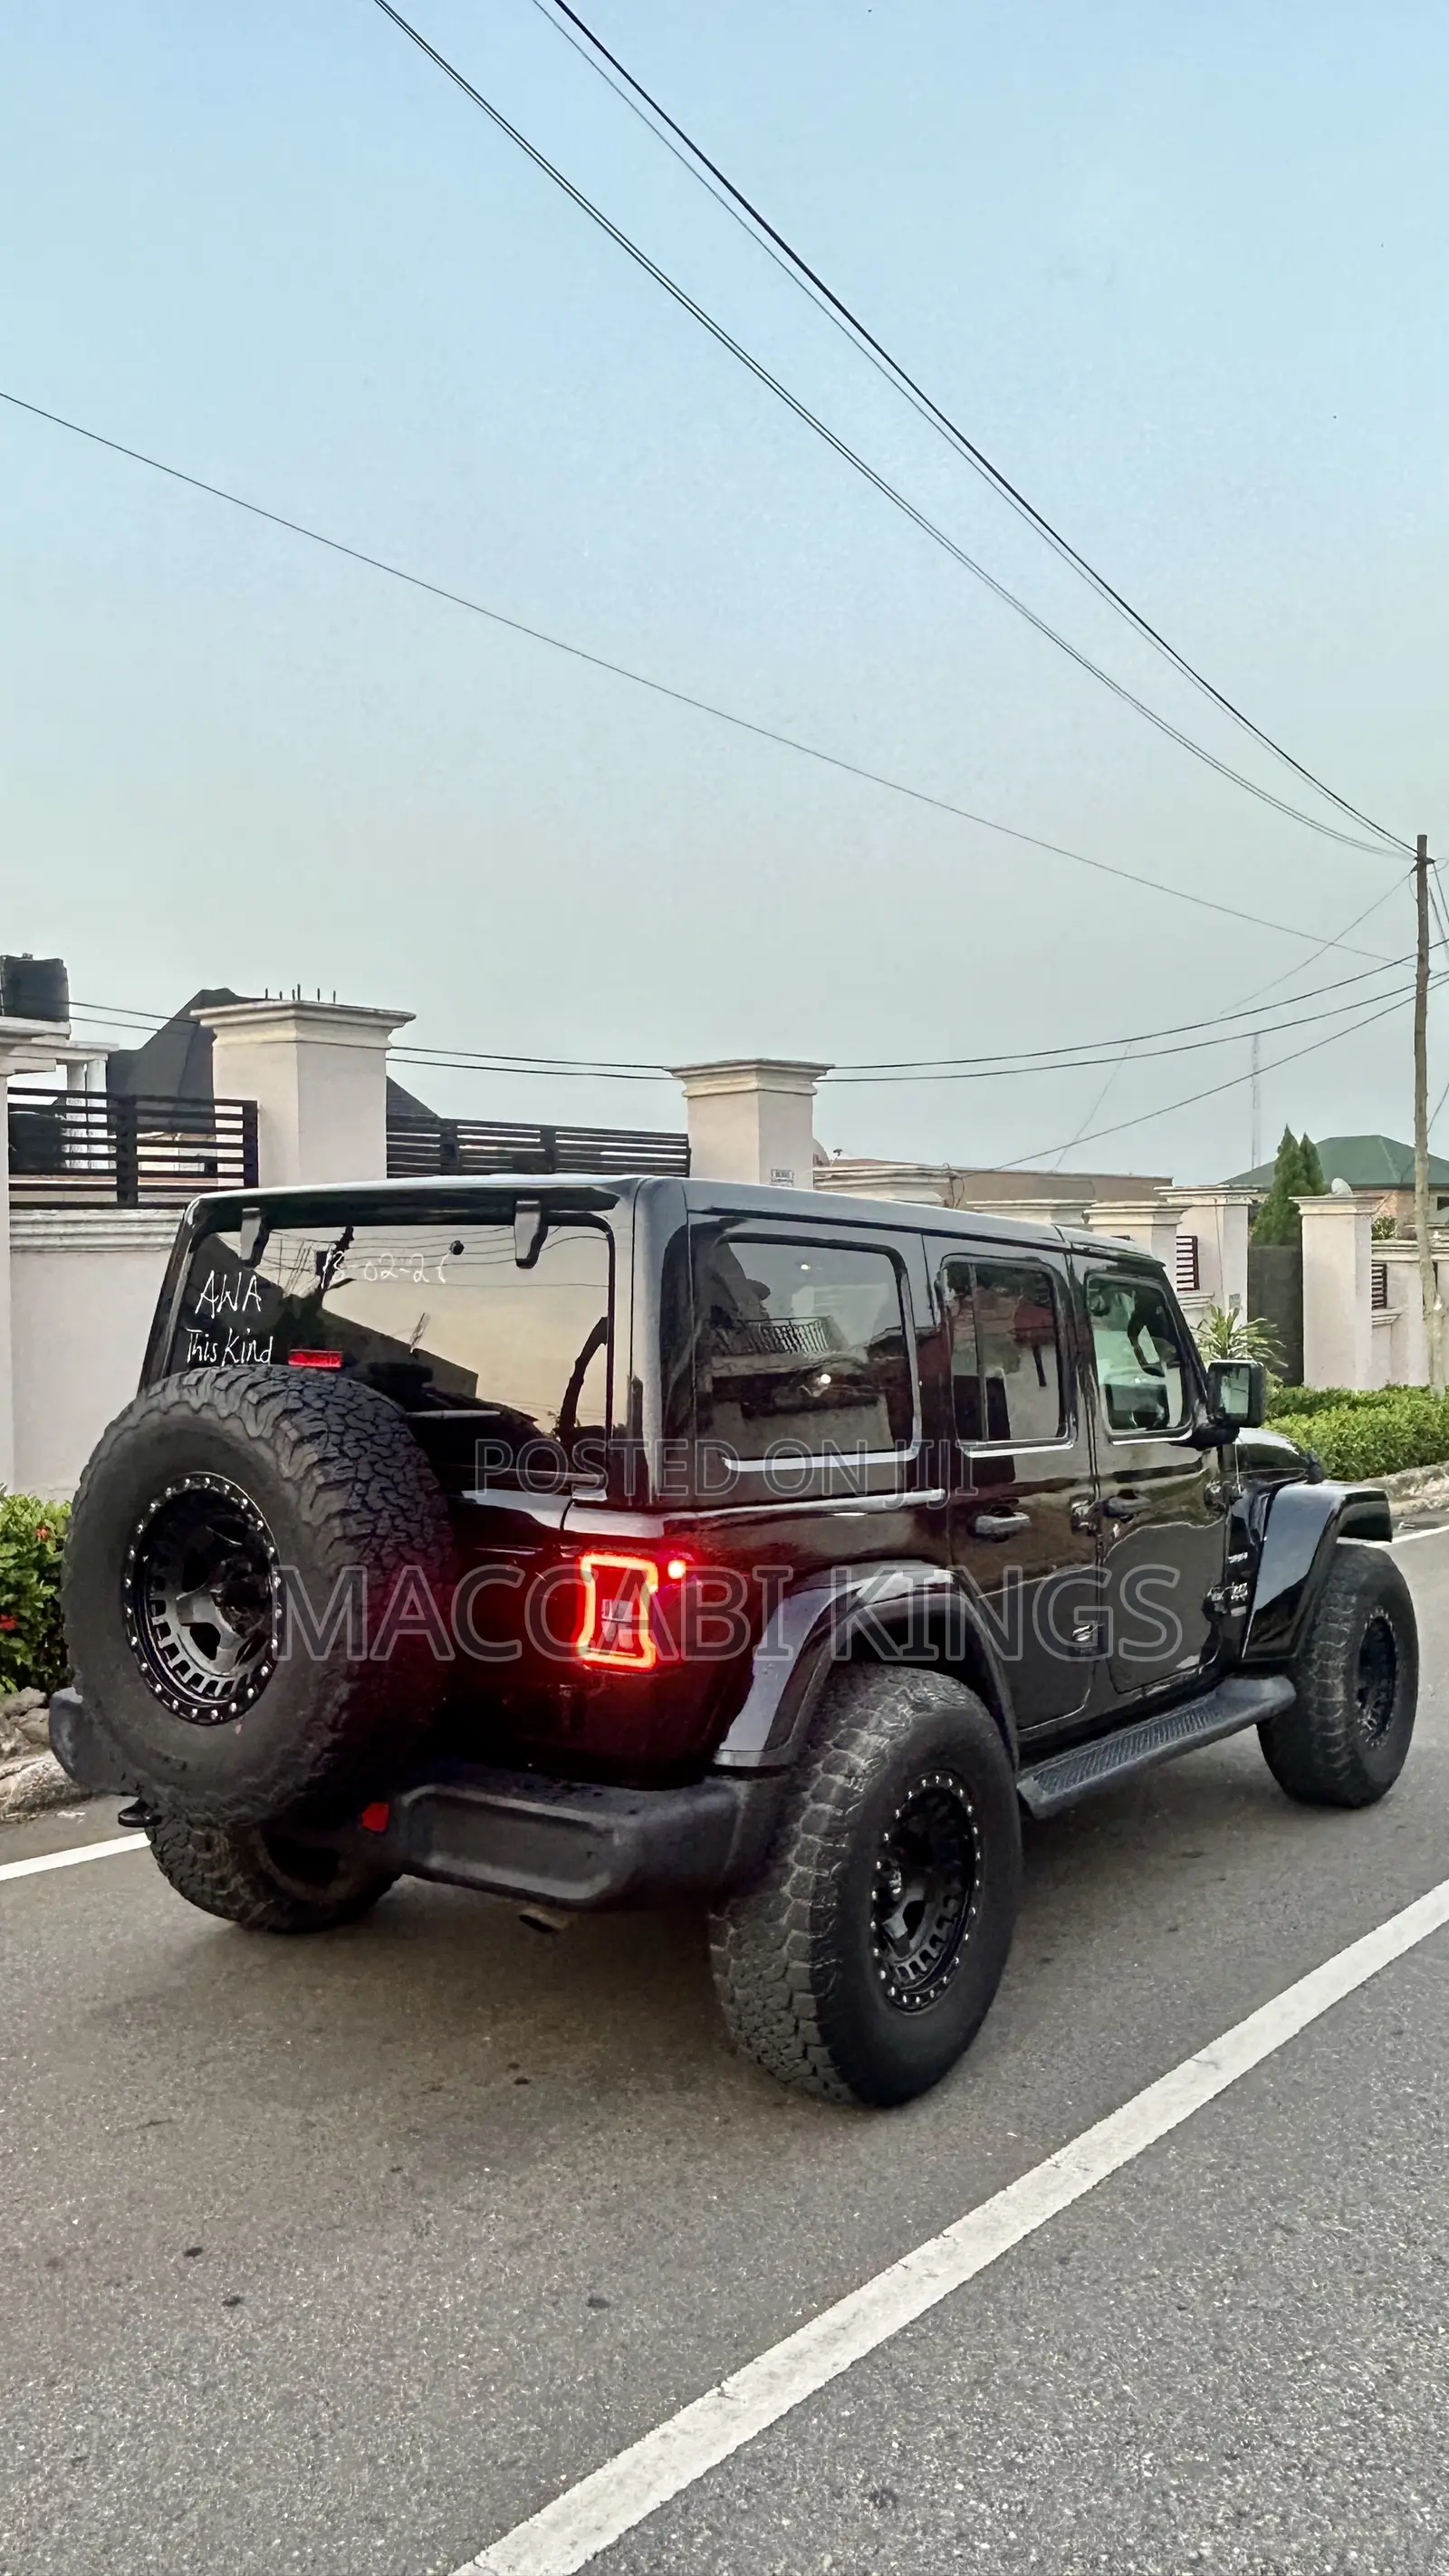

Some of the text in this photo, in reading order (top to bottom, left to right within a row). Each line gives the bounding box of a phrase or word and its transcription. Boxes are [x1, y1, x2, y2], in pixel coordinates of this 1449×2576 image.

[195, 1270, 262, 1319] AWA
[186, 1327, 273, 1367] This Kind
